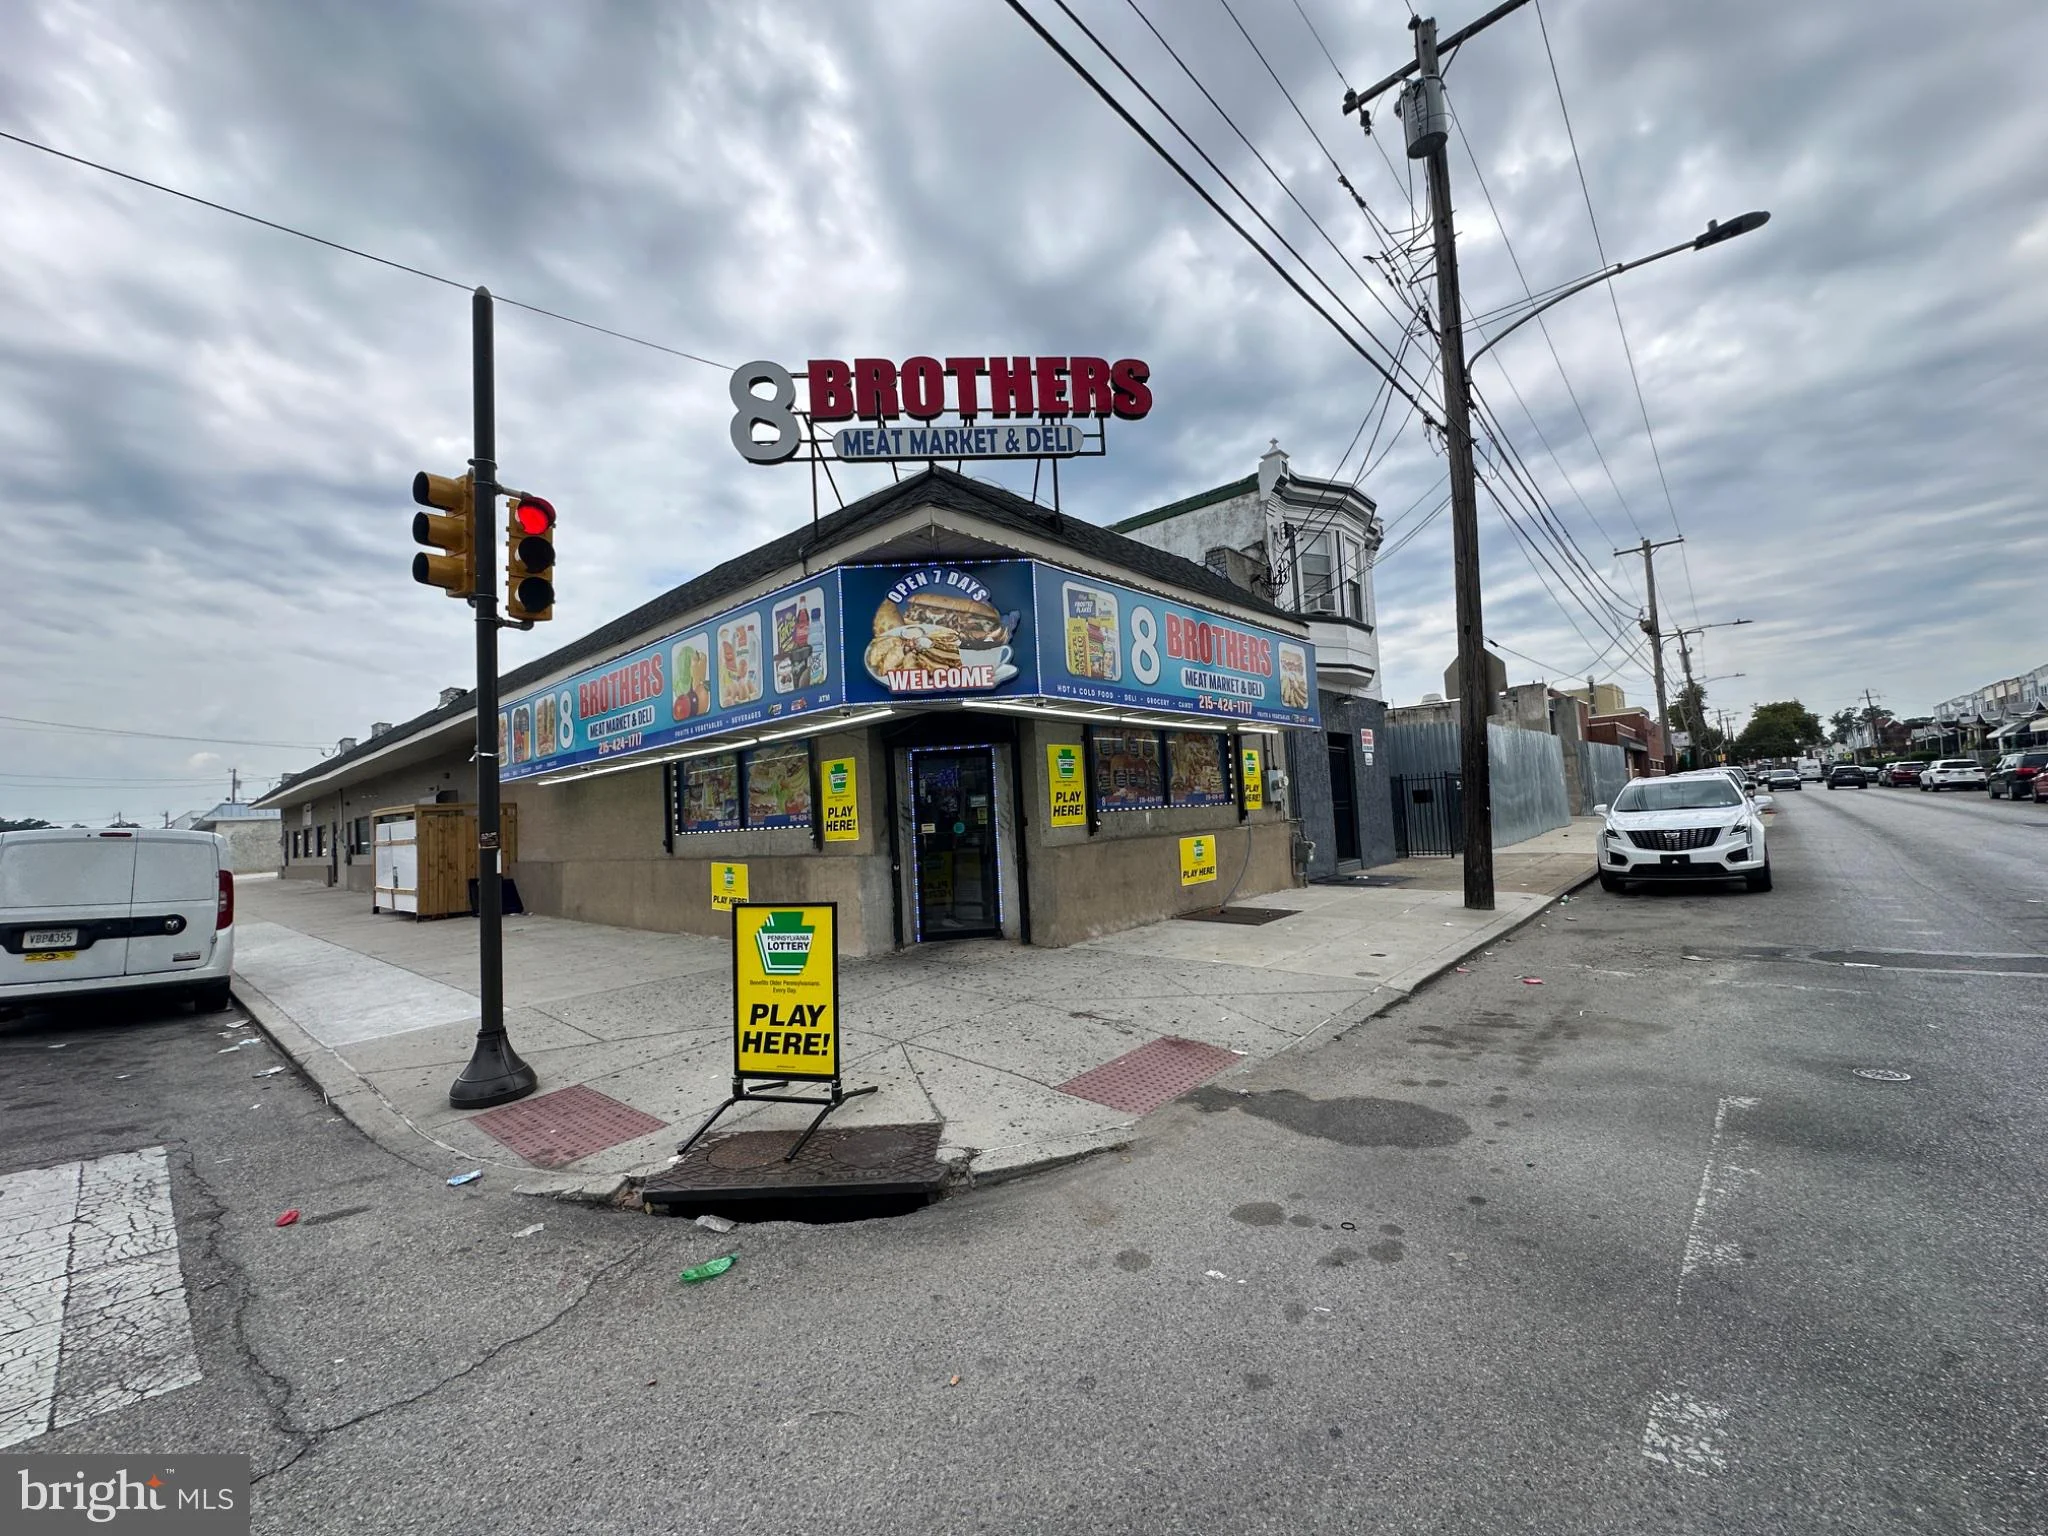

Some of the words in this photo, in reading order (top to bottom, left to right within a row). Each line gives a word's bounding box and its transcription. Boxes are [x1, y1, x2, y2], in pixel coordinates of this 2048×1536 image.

[729, 361, 801, 464] 8
[807, 356, 1153, 421] BROTHERS
[843, 431, 902, 456] MEAT
[908, 430, 997, 455] MARKET
[1004, 429, 1021, 454] &
[1025, 427, 1075, 453] DELI
[887, 571, 929, 604] OPEN
[932, 569, 943, 584] 7
[947, 571, 989, 602] DAYS
[1131, 605, 1161, 685] 8
[1165, 610, 1273, 678] BROTHERS
[887, 665, 994, 691] WELCOME
[1185, 669, 1207, 688] MEAT
[1208, 673, 1239, 695] MARKET
[1241, 681, 1247, 695] &
[1247, 682, 1263, 698] DELI
[559, 690, 575, 749] 8
[578, 652, 664, 720] BROTHERS
[1056, 684, 1071, 694] HOT
[1079, 688, 1096, 697] COLD
[1097, 690, 1115, 699] FOOD
[1124, 693, 1137, 702] DELI
[1146, 697, 1170, 706] GROCERY
[1198, 694, 1253, 715] 215-424-1717
[589, 721, 605, 739] MEAT
[606, 714, 631, 735] MARKET
[637, 706, 652, 725] DELI
[694, 721, 723, 734] VEGETABLES
[731, 711, 762, 725] BEVERAGES
[598, 732, 642, 755] 215-424-1717
[1055, 790, 1082, 803] PLAY
[827, 805, 853, 819] PLAY
[1053, 804, 1084, 817] HERE!
[825, 819, 856, 832] HERE!
[1183, 869, 1199, 879] PLAY
[1199, 865, 1215, 876] HERE!
[712, 895, 728, 904] PLAY
[767, 934, 810, 942] PENNSYLVANIA
[767, 941, 810, 951] LOTTERY
[749, 1003, 827, 1028] PLAY
[742, 1031, 831, 1056] HERE!
